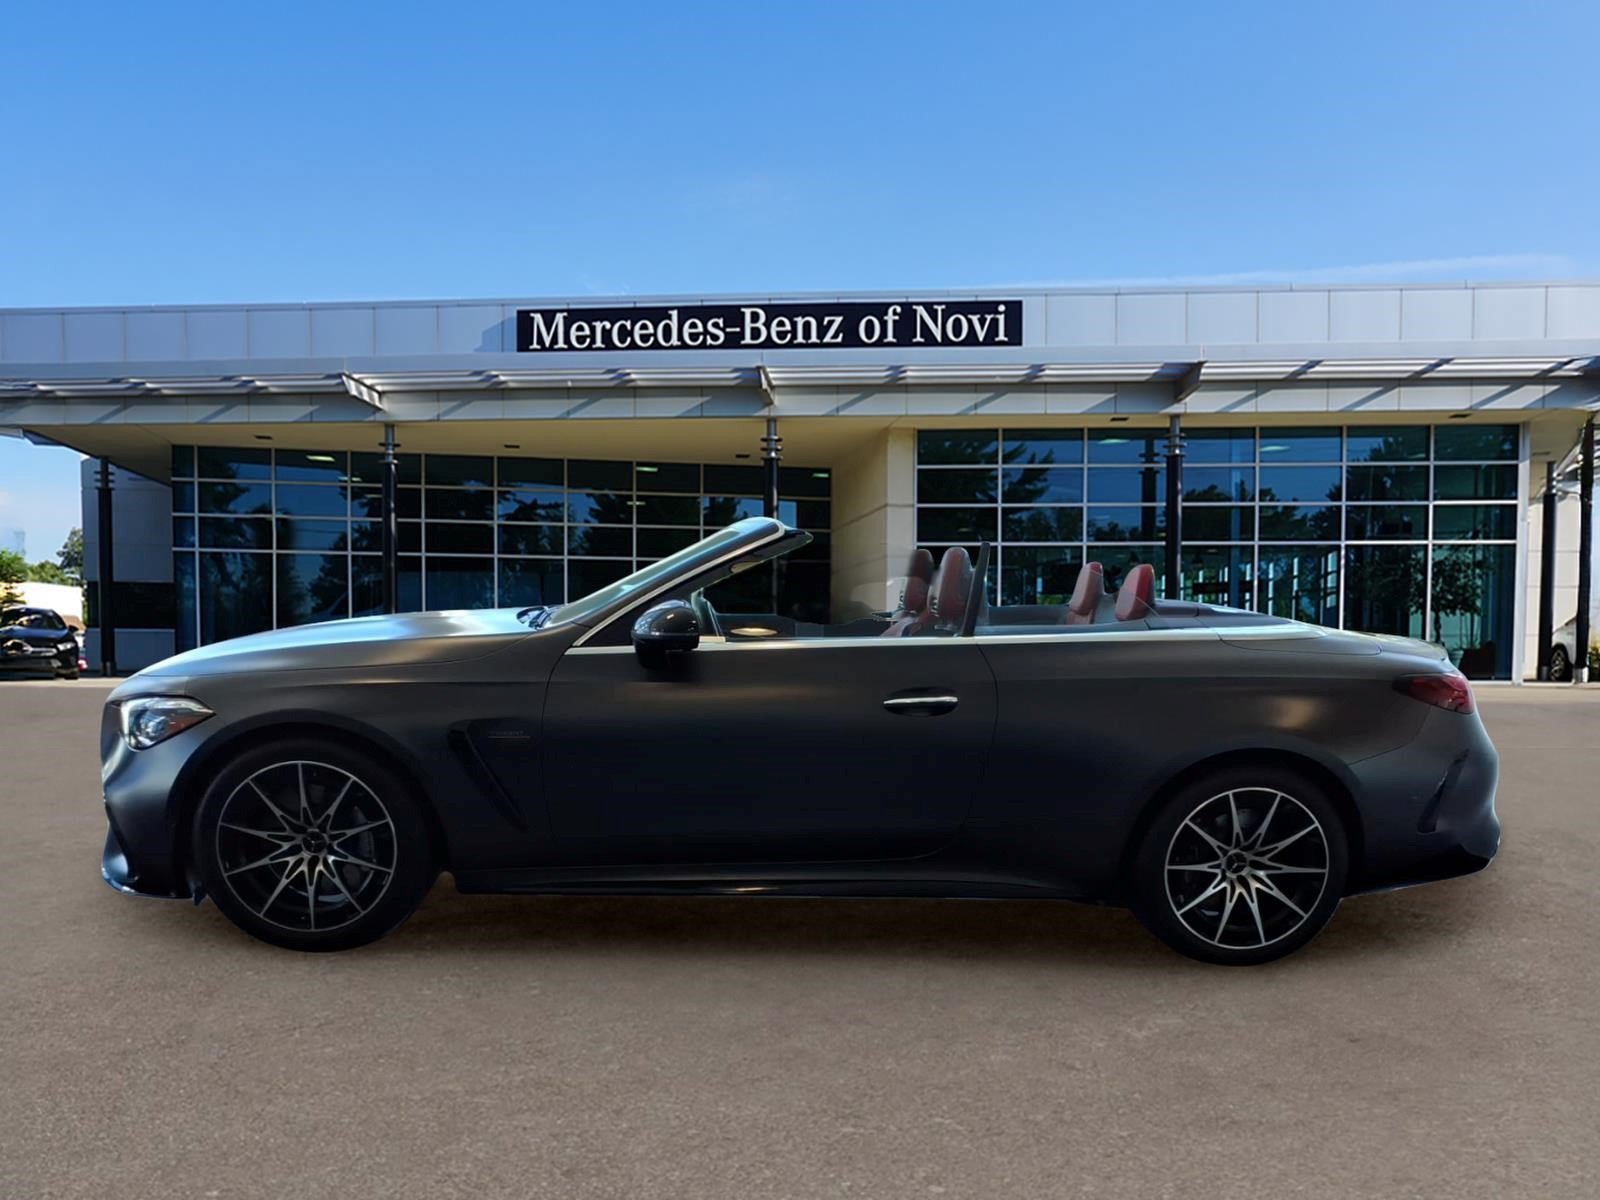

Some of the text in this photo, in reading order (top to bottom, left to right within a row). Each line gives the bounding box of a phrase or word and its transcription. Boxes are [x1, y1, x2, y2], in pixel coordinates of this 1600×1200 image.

[529, 305, 1009, 350] Mercedes-Benz of Novi
